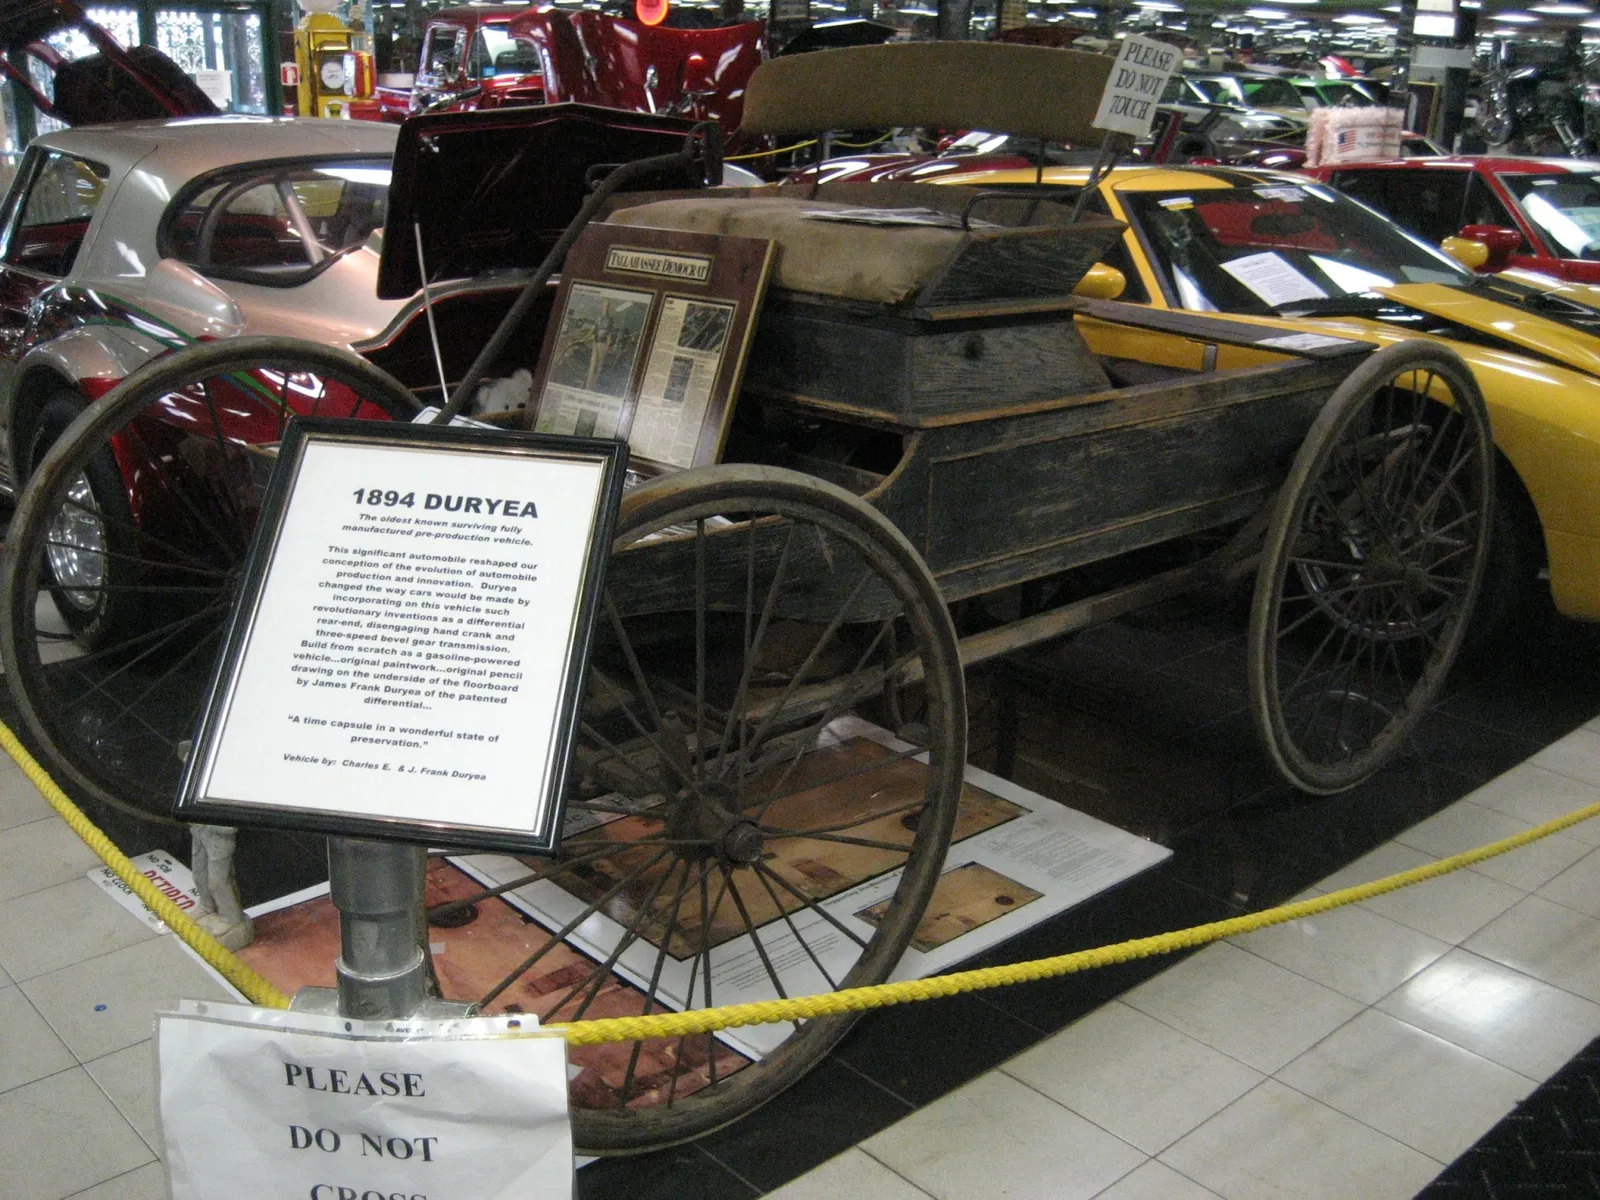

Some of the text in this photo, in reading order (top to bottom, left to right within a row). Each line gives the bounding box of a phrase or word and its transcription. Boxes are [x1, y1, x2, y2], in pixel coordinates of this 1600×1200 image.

[1123, 42, 1174, 71] PLEASE
[1115, 68, 1164, 96] DO NOT
[1109, 95, 1151, 120] TOUCH
[609, 252, 707, 278] TALLAHASSEE DEMOCRAT
[352, 487, 539, 519] 1894 DURYEA
[341, 524, 534, 545] manufactured pre-production vehicle.
[359, 512, 523, 534] The oldest known surviving fully
[328, 545, 350, 554] This
[351, 548, 407, 558] significant
[408, 553, 467, 563] automobile
[469, 558, 519, 568] reshaped
[321, 558, 380, 568] conception
[395, 562, 413, 571] the
[414, 565, 463, 575] evolution
[478, 571, 538, 582] automobile
[335, 571, 518, 592] production and innovation. Duryea
[318, 580, 363, 591] changed
[365, 584, 383, 592] the
[385, 587, 407, 596] way
[435, 591, 468, 599] would
[485, 595, 515, 604] made
[518, 598, 530, 607] by
[332, 593, 403, 608] incorporating
[420, 601, 441, 609] this
[443, 603, 482, 613] vehicle
[312, 605, 382, 618] revolutionary
[383, 610, 439, 621] inventions
[466, 617, 526, 629] differential
[316, 617, 516, 641] rear-end, disengaging hand crank and
[300, 639, 328, 649] Build
[329, 642, 355, 651] from
[357, 646, 398, 655] scratch
[425, 652, 521, 666] gasoline-powered
[315, 628, 511, 653] three-speed bevel gear transmission.
[290, 664, 334, 676] drawing
[352, 669, 371, 678] the
[372, 672, 426, 683] underside
[442, 677, 460, 686] the
[462, 679, 519, 692] floorboard
[488, 671, 524, 679] pencil
[295, 676, 310, 687] by
[311, 678, 348, 688] James
[349, 681, 381, 692] Frank
[383, 684, 422, 696] Duryea
[437, 690, 456, 699] the
[457, 693, 508, 704] patented
[303, 716, 328, 726] time
[329, 720, 373, 730] capsule
[398, 727, 454, 738] wonderful
[455, 732, 485, 741] state
[283, 753, 320, 763] Vehicle
[320, 757, 337, 766] by:
[341, 759, 380, 769] Charles
[419, 766, 449, 776] Frank
[450, 769, 487, 780] Duryea
[101, 868, 114, 878] NO
[283, 1061, 426, 1097] PLEASE
[288, 1124, 438, 1162] DO NOT
